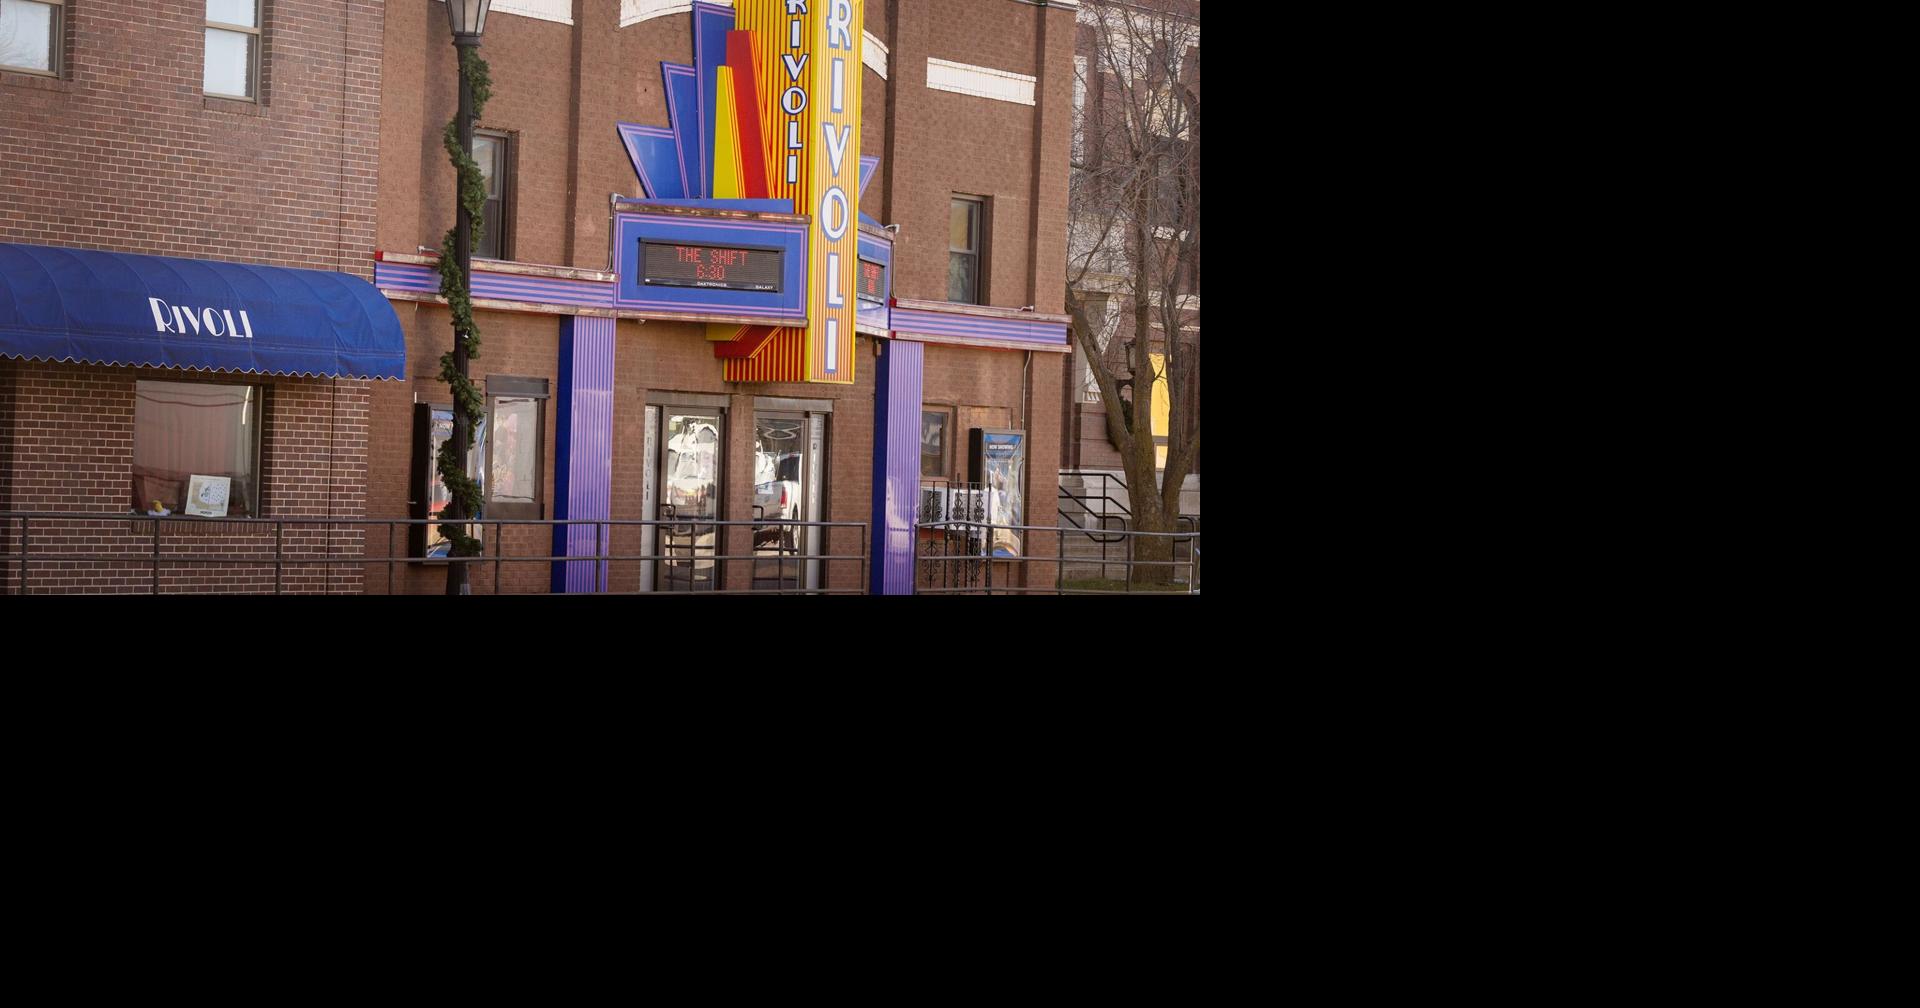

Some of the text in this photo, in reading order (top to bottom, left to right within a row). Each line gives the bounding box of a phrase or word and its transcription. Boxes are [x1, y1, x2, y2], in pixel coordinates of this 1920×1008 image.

[820, 0, 852, 374] RIVOLI
[675, 246, 749, 266] THE SHIFT
[696, 264, 725, 280] 6:30
[148, 297, 253, 338] RIVOLI
